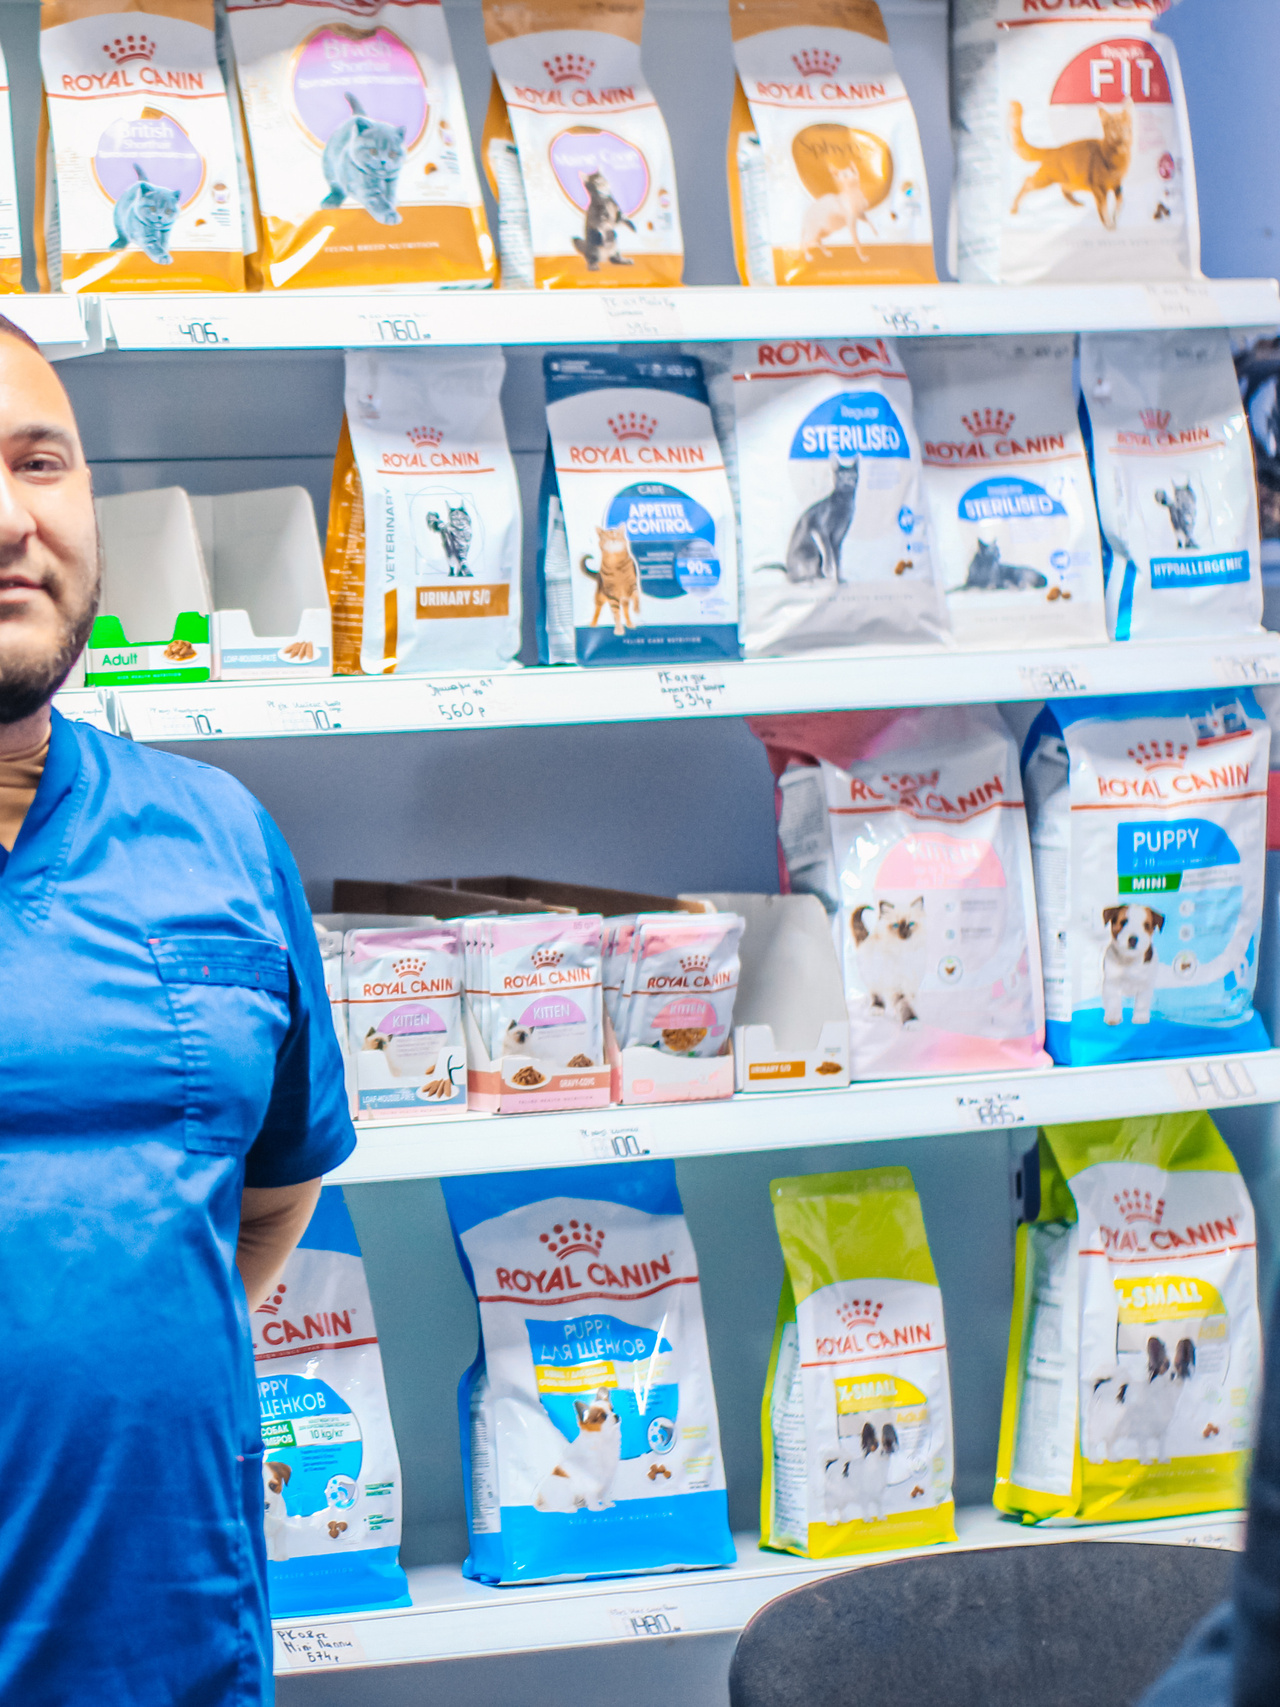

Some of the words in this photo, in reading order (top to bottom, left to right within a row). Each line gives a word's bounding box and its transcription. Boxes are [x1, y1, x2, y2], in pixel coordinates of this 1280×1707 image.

[61, 70, 134, 91] ROYAL
[139, 67, 204, 90] CANIN
[1089, 59, 1154, 97] FIT
[514, 86, 567, 106] ROYAL
[572, 86, 636, 106] CANIN
[756, 81, 815, 101] ROYAL
[820, 82, 886, 101] CANIN
[388, 241, 439, 249] NUTRITION
[178, 322, 219, 343] 406
[377, 320, 421, 341] 1760
[802, 425, 900, 453] STERILISED
[924, 440, 990, 460] ROYAL
[994, 432, 1065, 457] CANIN
[1156, 427, 1210, 446] CANIN
[382, 453, 427, 468] ROYAL
[430, 451, 480, 467] CANIN
[570, 446, 634, 464] ROYAL
[637, 446, 705, 463] CANIN
[638, 486, 665, 495] CARE
[628, 504, 684, 518] APPETITE
[964, 494, 1053, 519] STERILISED
[383, 487, 396, 583] VETERINARY
[627, 518, 694, 534] CONTROL
[420, 590, 471, 607] URINARY
[102, 653, 138, 666] Adult
[304, 710, 331, 731] 70
[438, 701, 475, 721] 560
[185, 714, 213, 736] 70
[1098, 776, 1168, 799] ROYAL
[1173, 764, 1249, 792] CANIN
[925, 775, 1004, 815] CANIN
[1132, 827, 1199, 853] PUPPY
[1132, 876, 1167, 891] MINI
[363, 982, 407, 997] ROYAL
[410, 978, 453, 993] CANIN
[504, 972, 546, 989] ROYAL
[549, 967, 591, 985] CANIN
[647, 976, 690, 989] ROYAL
[693, 971, 731, 987] CANIN
[533, 1004, 570, 1020] KITTEN
[670, 1003, 706, 1015] KITTEN
[392, 1013, 430, 1028] KITTEN
[1150, 1216, 1237, 1250] CANIN
[496, 1264, 582, 1293] ROYAL
[587, 1253, 671, 1288] CANIN
[262, 1310, 352, 1345] CANIN
[563, 1320, 611, 1340] PUPPY
[541, 1344, 573, 1360] ДЛЯ
[576, 1338, 646, 1359] ЩЕНКОВ
[816, 1334, 863, 1356] ROYAL
[866, 1323, 931, 1349] CANIN
[838, 1380, 897, 1402] X-SMALL
[310, 1429, 320, 1439] 10
[629, 1511, 673, 1521] NUTRITION
